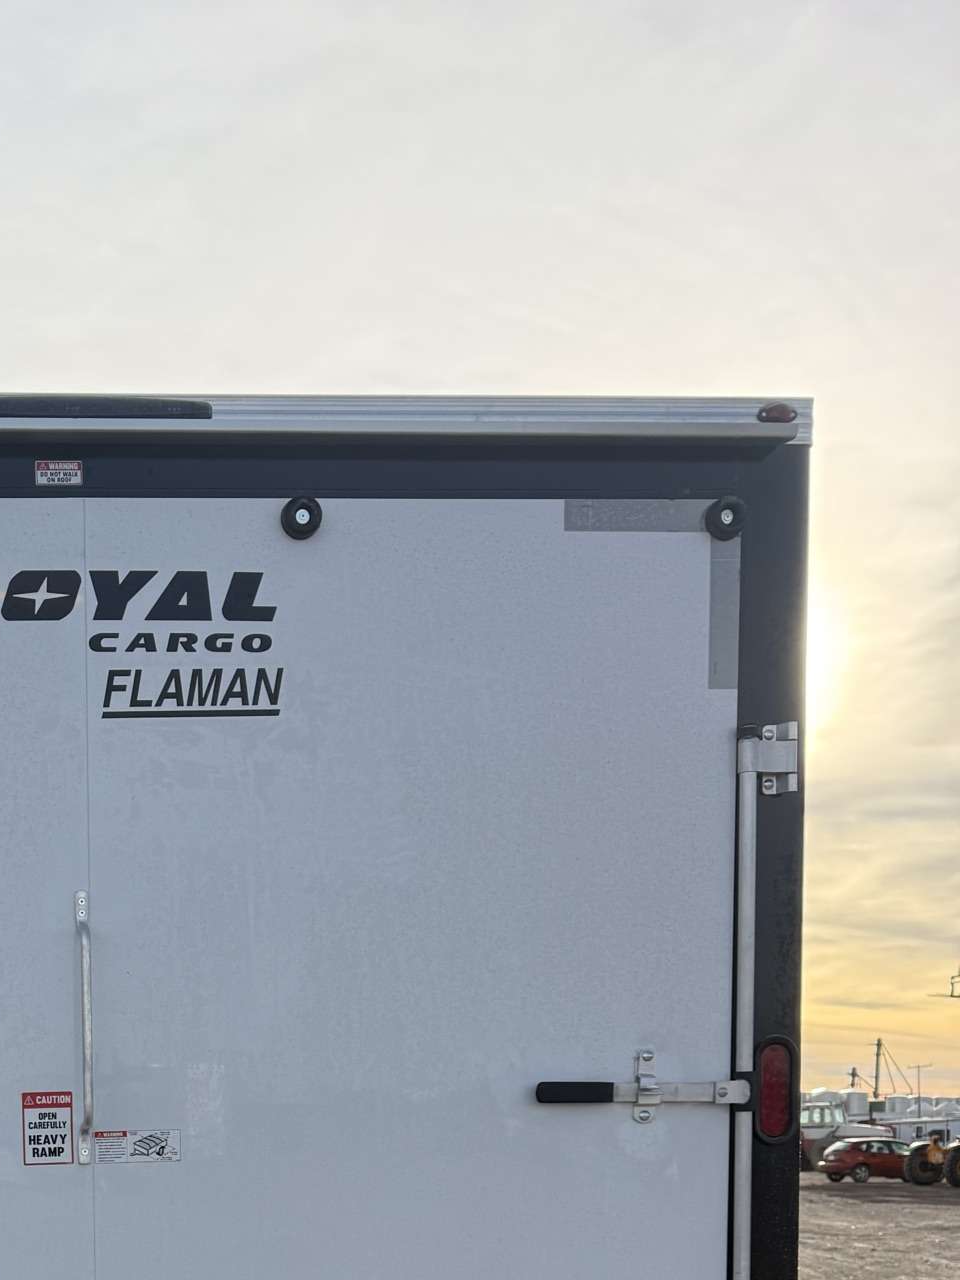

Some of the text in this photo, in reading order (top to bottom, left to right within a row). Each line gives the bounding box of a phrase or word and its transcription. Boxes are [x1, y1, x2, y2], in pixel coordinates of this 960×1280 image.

[88, 632, 273, 653] CARGO
[102, 667, 284, 709] FLAMAN
[35, 1095, 72, 1105] CAUTION
[38, 1112, 57, 1121] OPEN
[28, 1120, 67, 1130] CAREFULLY
[28, 1134, 67, 1145] HEAVY
[32, 1147, 65, 1158] RAMP
